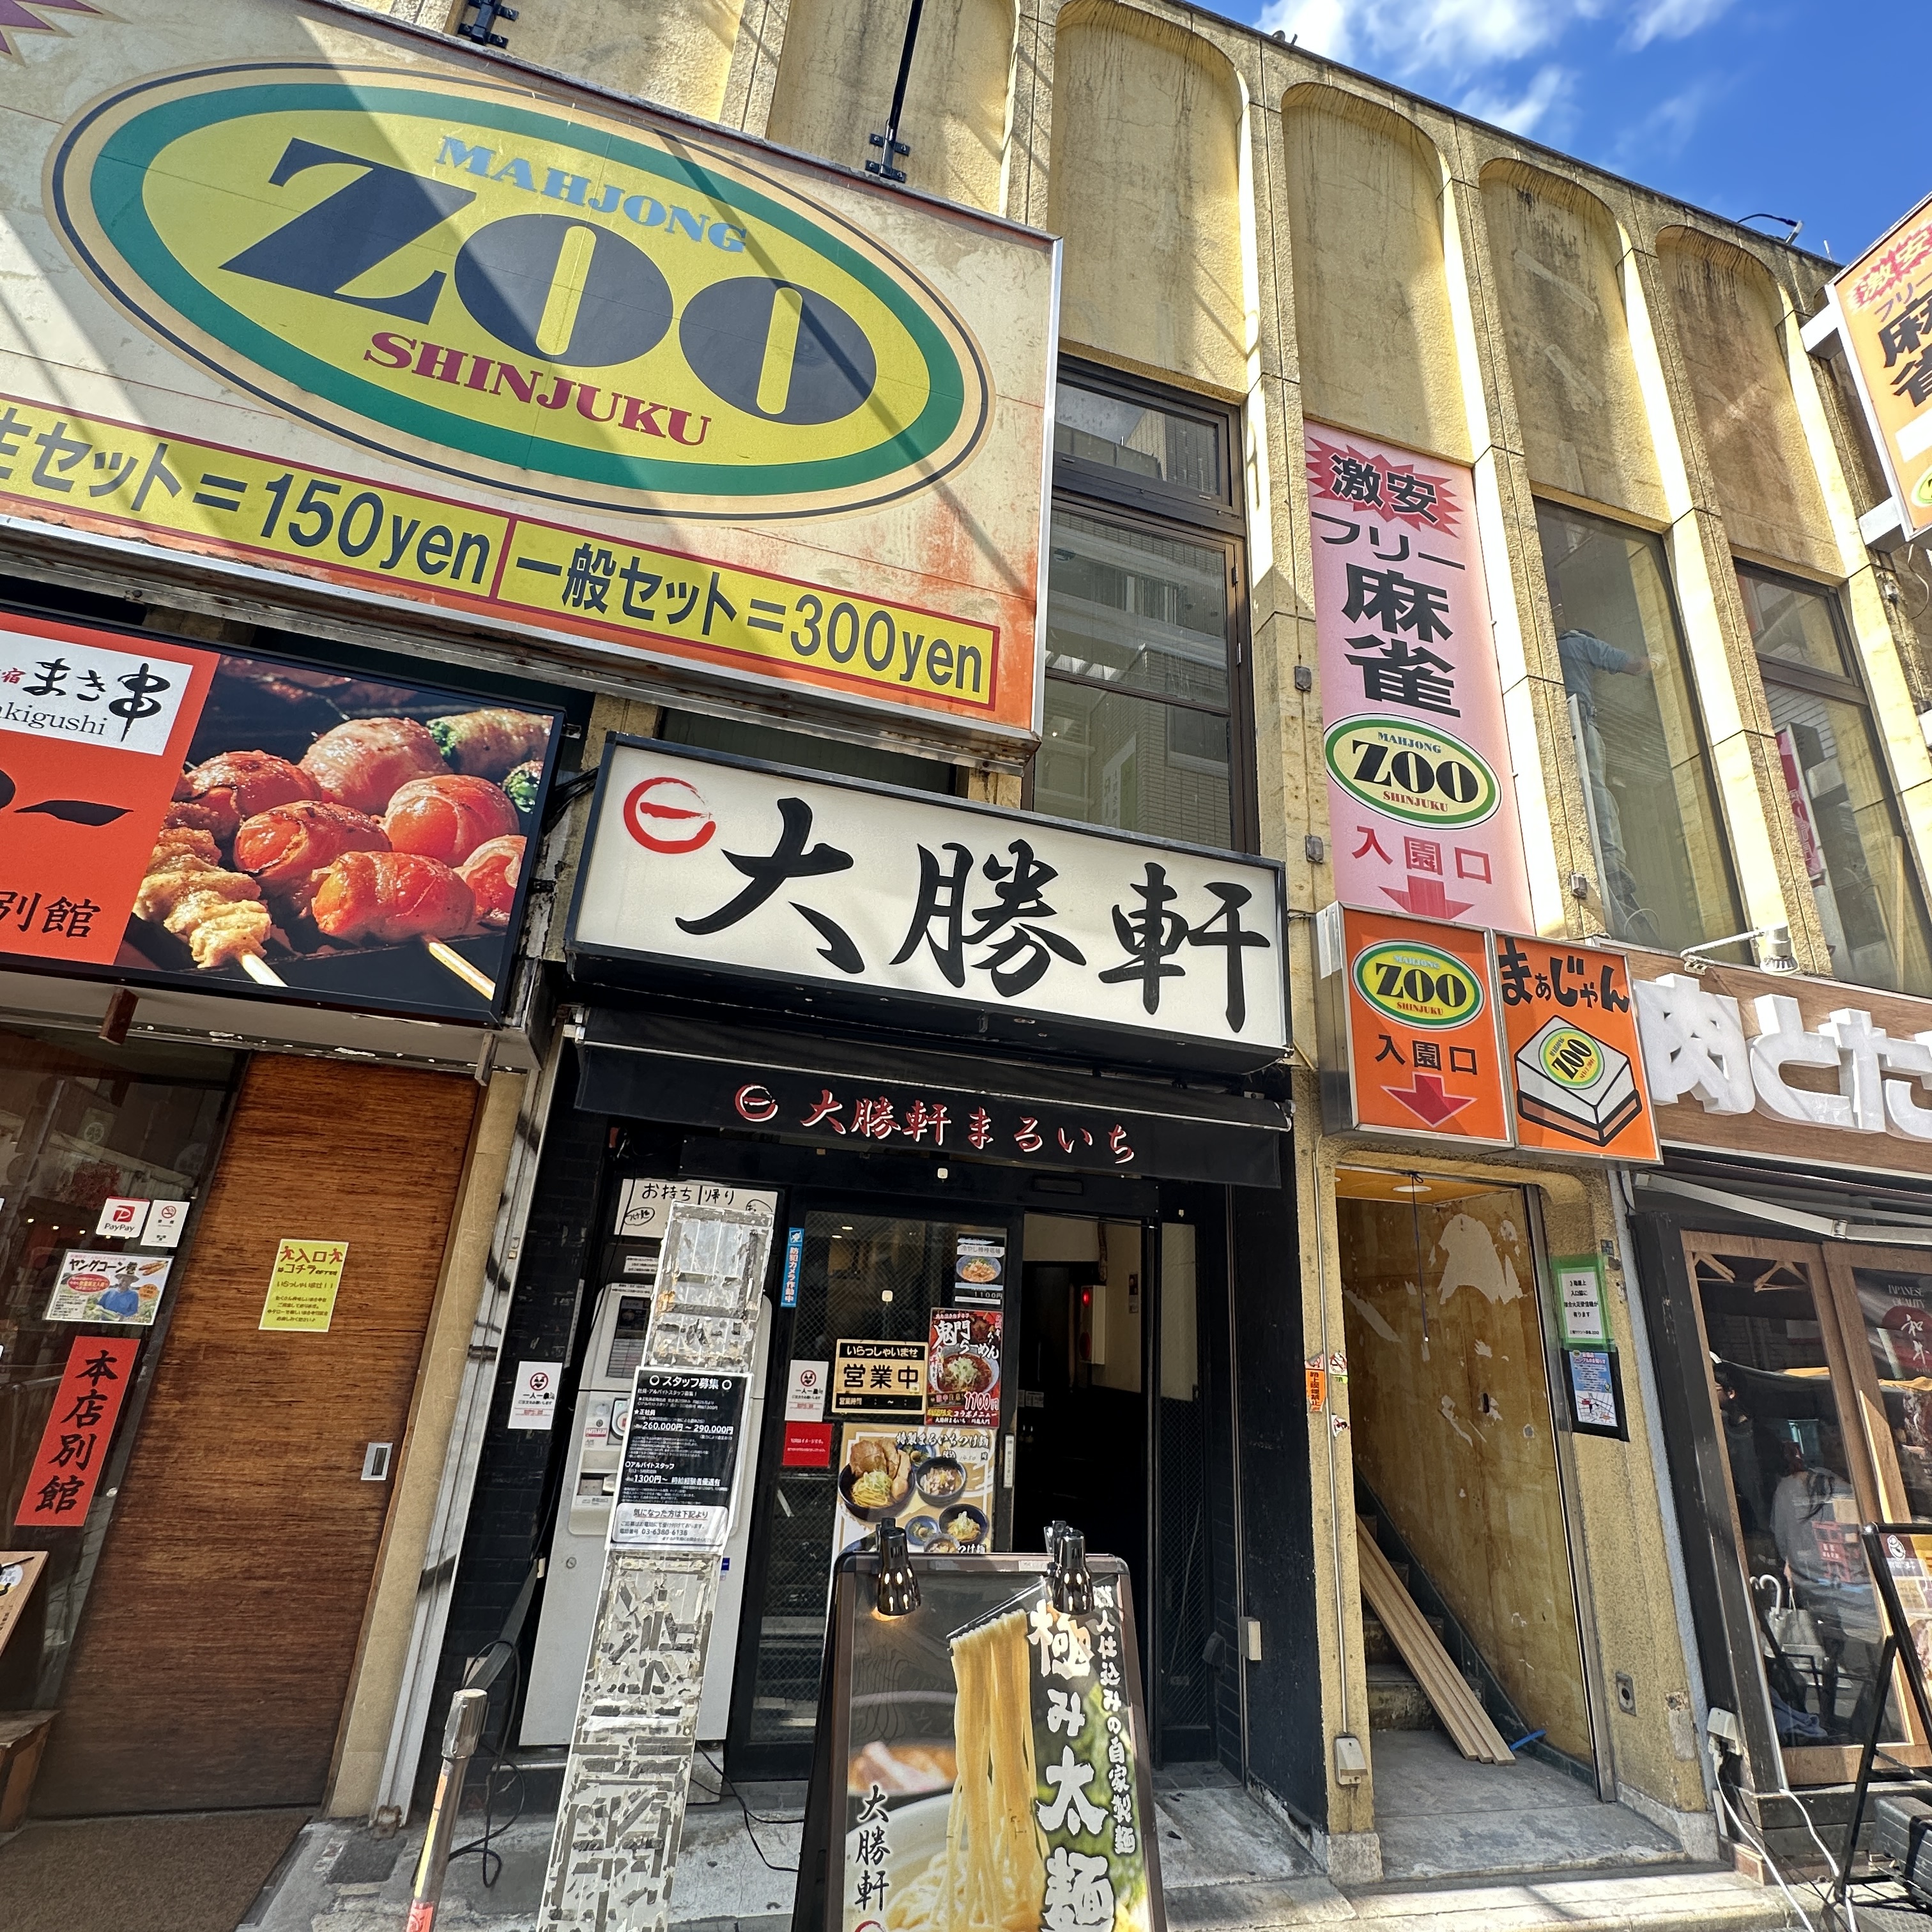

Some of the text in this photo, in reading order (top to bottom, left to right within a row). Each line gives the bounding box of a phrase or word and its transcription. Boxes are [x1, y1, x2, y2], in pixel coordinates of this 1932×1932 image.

[436, 135, 746, 253] MAHJONG
[218, 137, 877, 425] ZOO
[364, 332, 711, 446] SHINJUKU
[1331, 452, 1438, 523] 激安
[1312, 512, 1466, 570] フリー
[1342, 564, 1461, 717] 麻雀
[22, 658, 171, 742] まき串
[1377, 731, 1441, 755] MAHJONG
[1351, 740, 1478, 804] ZOO
[1383, 790, 1448, 813] SHINJUKU
[1351, 825, 1492, 884] 入園口
[675, 797, 1270, 1032] 大勝軒
[1376, 963, 1466, 1008] ZOO
[1393, 954, 1440, 969] MAHJONG
[1397, 1002, 1444, 1015] SHINJUKU
[1375, 1034, 1478, 1075] 入園口
[1551, 1039, 1592, 1080] ZOO
[104, 1223, 135, 1232] PayPay
[295, 1248, 327, 1263] 入口
[843, 1363, 919, 1389] 営業中
[847, 1346, 918, 1357] いらっしゃいませ
[662, 1376, 719, 1390] スタッフ募集
[35, 1351, 119, 1513] 本店別館
[855, 1784, 891, 1911] 大勝軒
